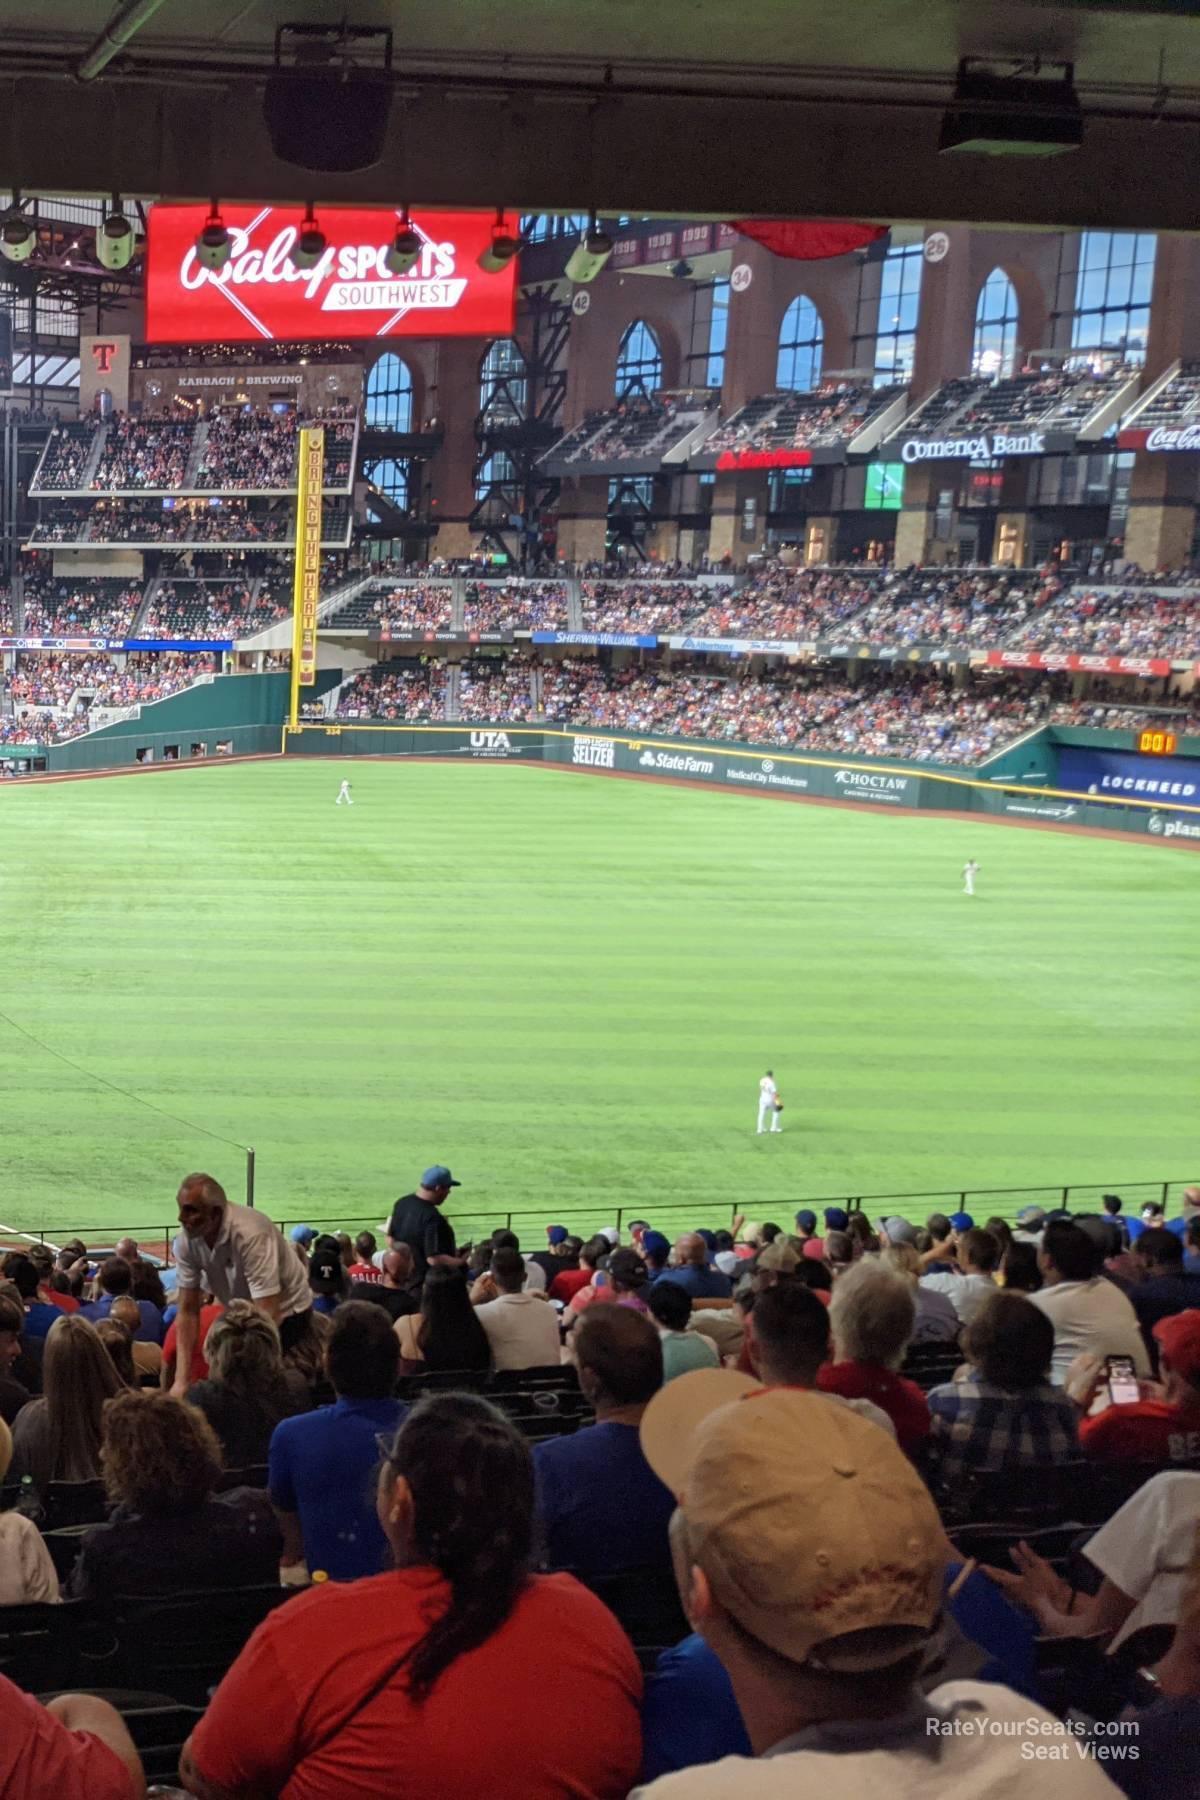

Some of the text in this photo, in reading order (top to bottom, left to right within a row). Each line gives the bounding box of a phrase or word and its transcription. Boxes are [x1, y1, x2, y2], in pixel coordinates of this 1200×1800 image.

[927, 237, 944, 256] 26
[181, 227, 334, 298] Baly
[734, 272, 749, 286] 34
[338, 283, 449, 305] SOUTHWEST
[575, 296, 588, 311] 42
[92, 344, 116, 372] T
[178, 375, 303, 386] KARBACH BREWING
[992, 433, 1045, 454] Bank
[1001, 652, 1029, 662] DEX
[1039, 654, 1068, 664] DEX
[1078, 656, 1108, 666] DEX
[1120, 659, 1150, 668] DEX
[470, 732, 511, 747] UTA
[573, 744, 614, 767] SELTZER
[1102, 776, 1196, 797] LOCKHEED
